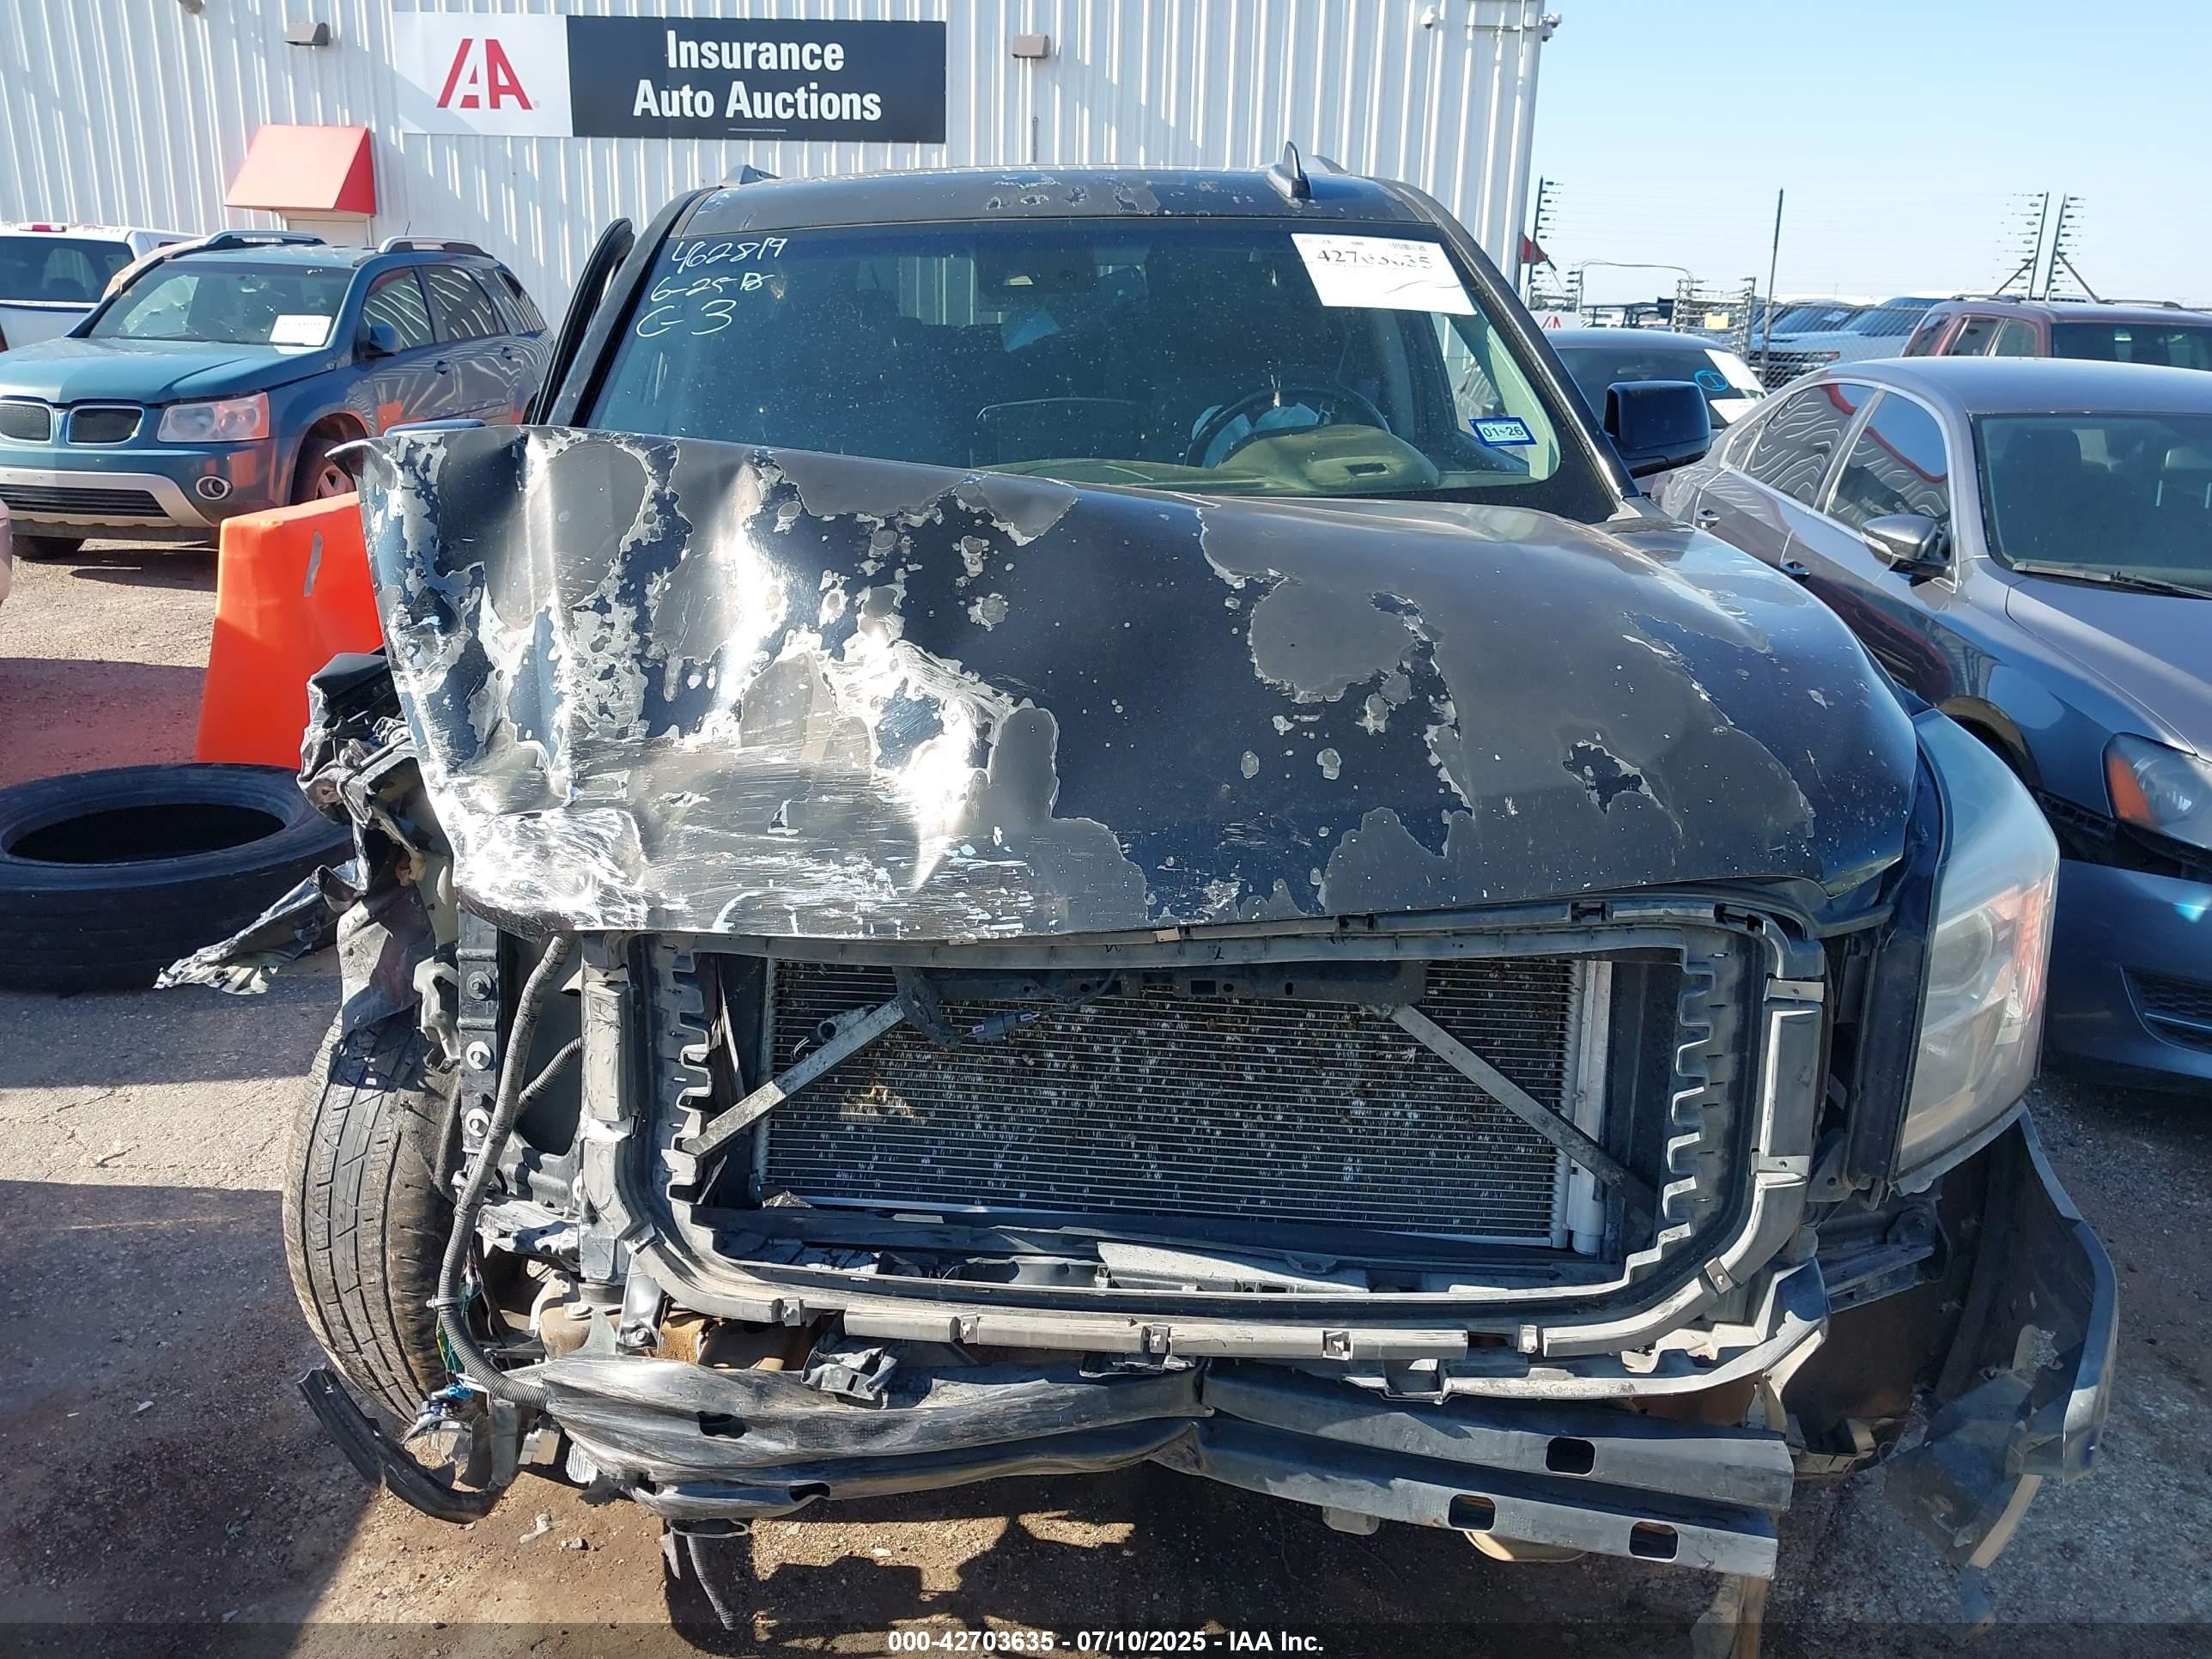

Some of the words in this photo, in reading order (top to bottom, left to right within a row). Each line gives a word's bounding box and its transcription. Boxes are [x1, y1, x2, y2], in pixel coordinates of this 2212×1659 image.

[666, 29, 845, 71] Insurance
[632, 79, 714, 118] Auto
[725, 81, 883, 122] Auctions
